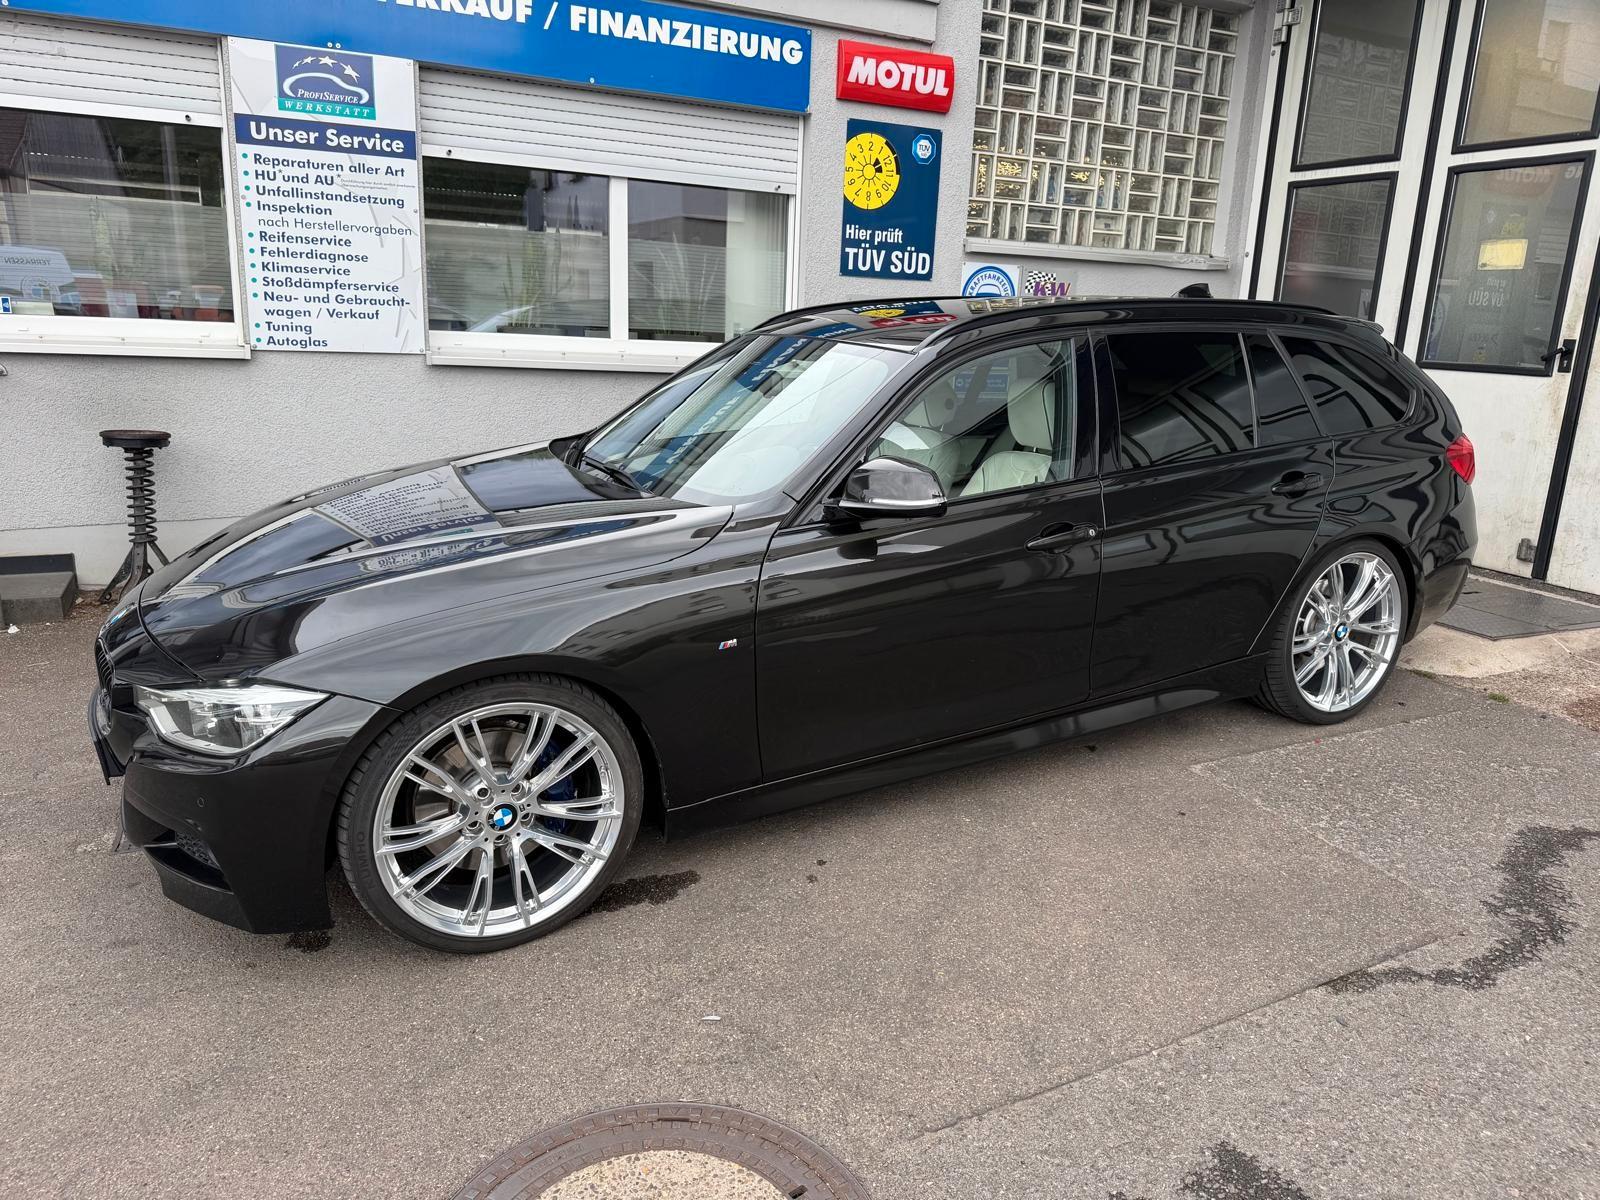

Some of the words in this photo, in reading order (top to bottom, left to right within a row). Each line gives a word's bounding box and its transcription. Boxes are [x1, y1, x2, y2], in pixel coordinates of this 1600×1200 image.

[570, 4, 804, 65] FINANZIERUNG
[847, 55, 950, 97] MOTUL
[285, 100, 370, 117] WERKSTATT
[250, 121, 319, 145] Unser
[325, 128, 405, 153] Service
[857, 144, 864, 154] 3
[869, 141, 874, 152] 2
[878, 146, 884, 154] 1
[850, 152, 857, 161] 4
[883, 155, 893, 167] 12
[253, 153, 344, 172] Reparaturen
[348, 162, 381, 175] aller
[384, 165, 405, 178] Art
[282, 172, 309, 184] und
[256, 185, 405, 208] Unfallinstandsetzung
[866, 191, 871, 201] 8
[875, 188, 882, 198] 9
[257, 200, 333, 216] Inspektion
[258, 217, 289, 228] nach
[294, 218, 412, 237] Herstellervorgaben
[845, 224, 872, 241] Hier
[874, 228, 903, 246] prüft
[259, 230, 352, 247] Reifenservice
[260, 246, 369, 264] Fehlerdiagnose
[845, 243, 886, 272] TÜV
[890, 246, 931, 275] SÜD
[261, 261, 351, 276] Klimaservice
[262, 276, 399, 293] Stoßdämpferservice
[1033, 281, 1071, 297] KW
[263, 291, 298, 303] Neu-
[303, 293, 330, 304] und
[335, 294, 411, 307] Gebraucht-
[264, 308, 312, 319] wagen
[326, 308, 380, 320] Verkauf
[265, 321, 313, 335] Tuning
[266, 335, 328, 349] Autoglas
